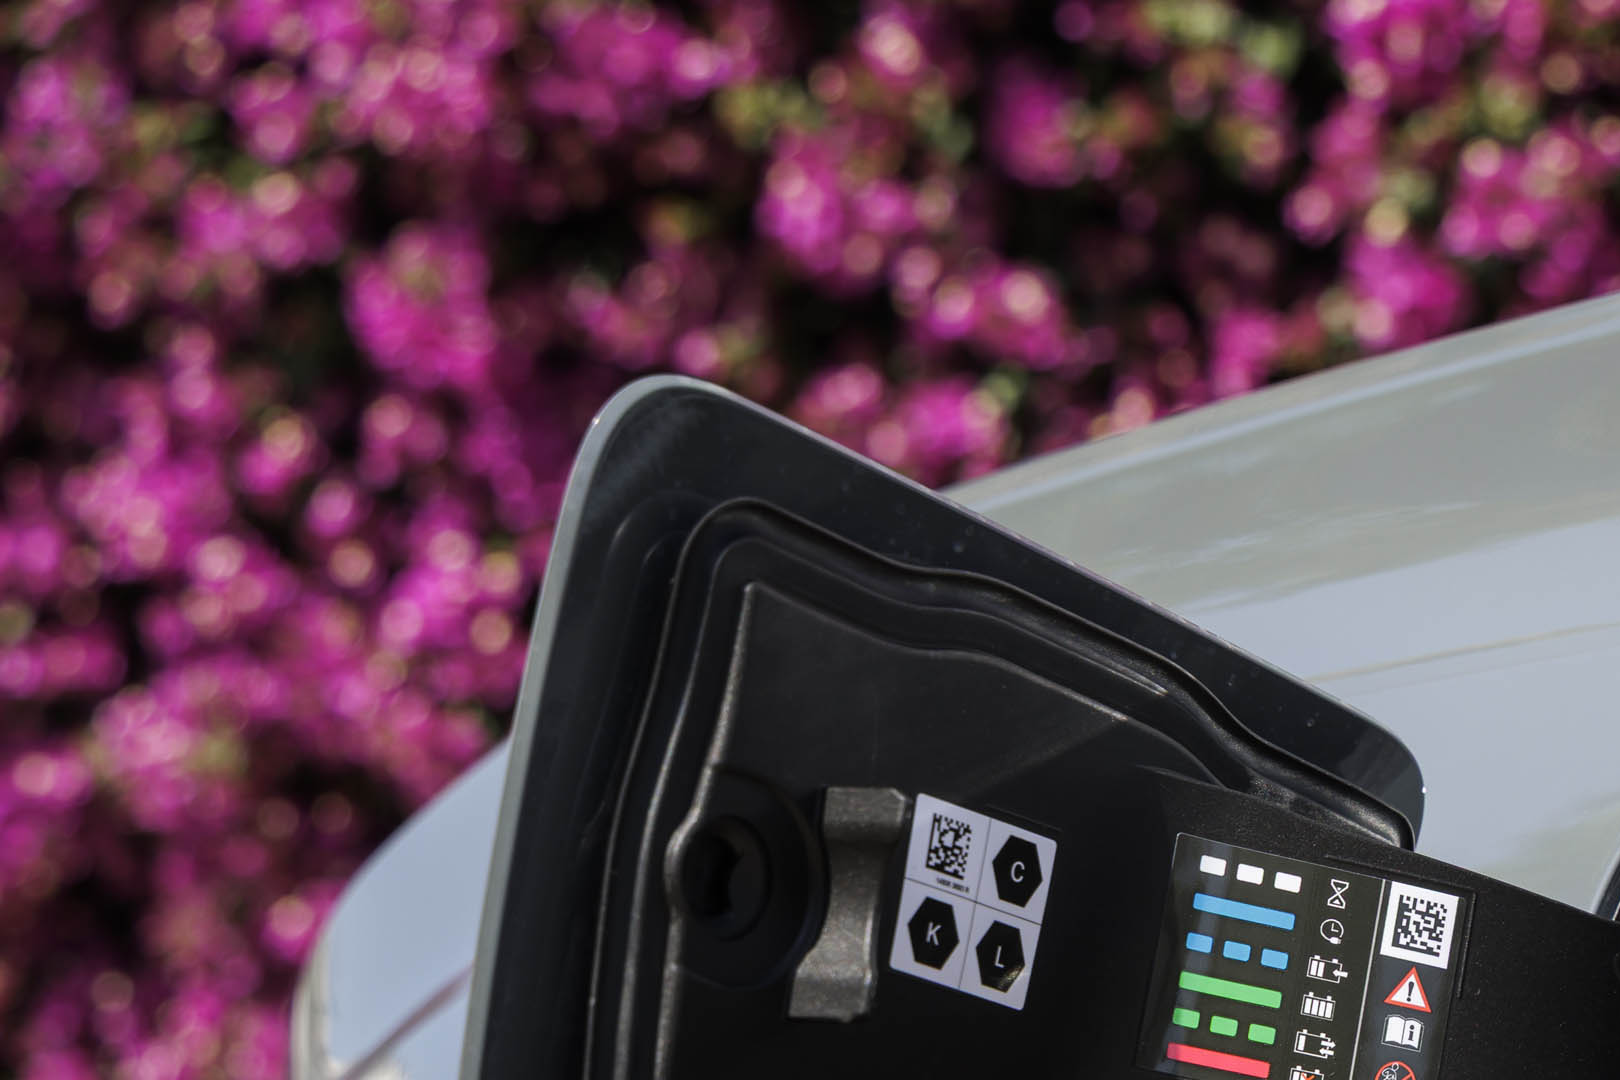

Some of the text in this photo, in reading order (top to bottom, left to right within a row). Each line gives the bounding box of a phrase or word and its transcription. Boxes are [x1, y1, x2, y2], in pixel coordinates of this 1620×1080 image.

[1010, 861, 1026, 883] C
[925, 921, 942, 946] K
[994, 945, 1005, 968] L
